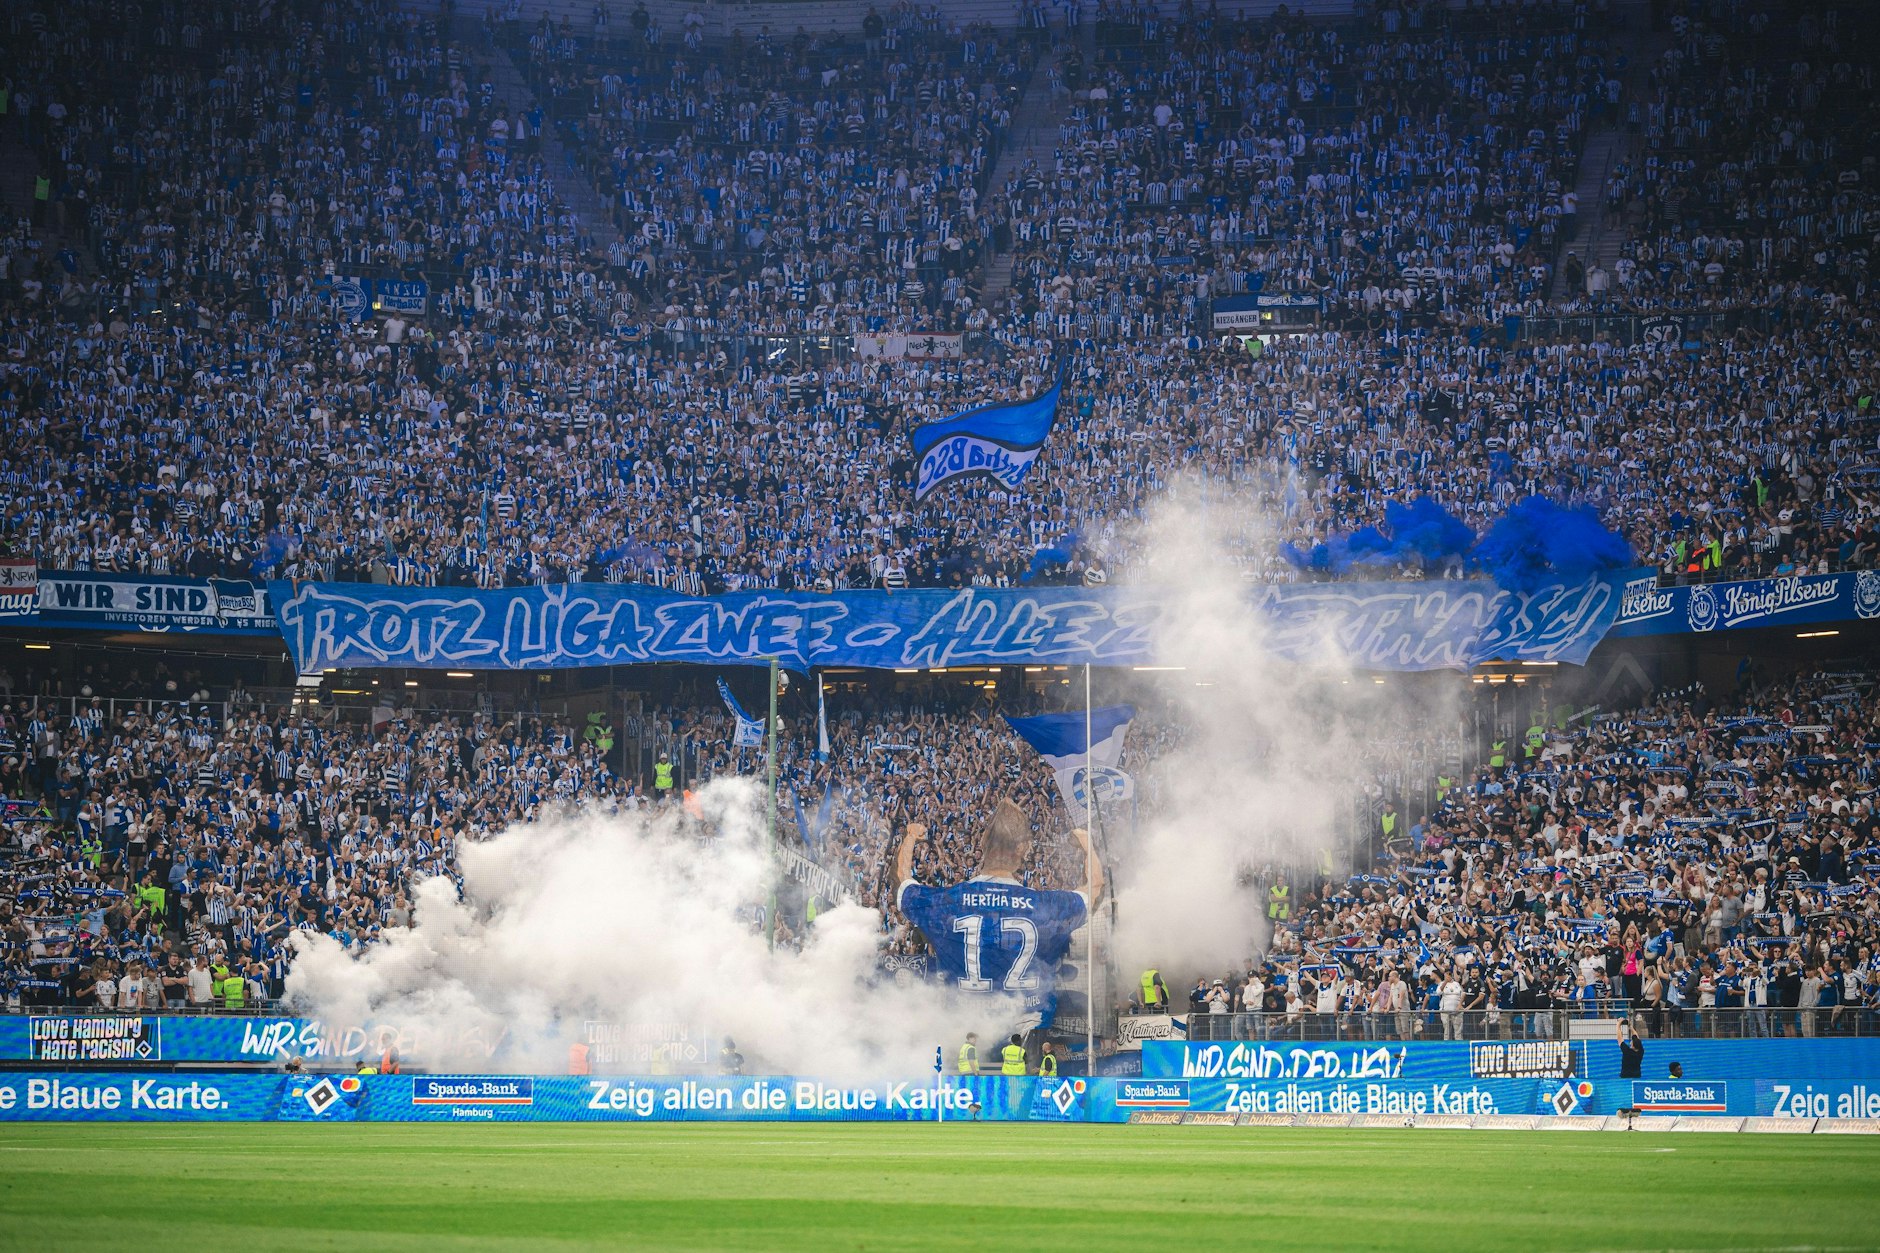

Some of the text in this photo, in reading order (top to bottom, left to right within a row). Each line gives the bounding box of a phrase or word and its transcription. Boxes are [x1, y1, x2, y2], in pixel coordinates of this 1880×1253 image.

[12, 571, 36, 582] NRW
[55, 583, 208, 613] WIR SIND
[1724, 585, 1777, 616] König
[1770, 575, 1839, 607] Pilsener
[104, 612, 166, 624] INVESTOREN
[172, 615, 214, 626] WERDEN
[280, 584, 500, 673] TROTZ
[501, 584, 652, 668] LIGA
[902, 587, 1105, 667] ALLE
[962, 893, 1034, 909] HERTHA BSC
[953, 914, 1040, 993] 12
[27, 1078, 122, 1110] Blaue
[131, 1079, 229, 1109] Karte.
[428, 1081, 519, 1099] Sparda-Bank
[587, 1081, 655, 1116] Zeig
[663, 1081, 733, 1110] allen
[742, 1081, 787, 1110] die
[795, 1081, 877, 1110] Blaue
[1124, 1084, 1181, 1098] Sparda-Bank
[1225, 1083, 1499, 1114] Zeig allen die Blaue Karte.
[1643, 1086, 1715, 1103] Sparda-Bank
[1772, 1085, 1830, 1118] Zeig
[452, 1107, 494, 1119] Hamburg
